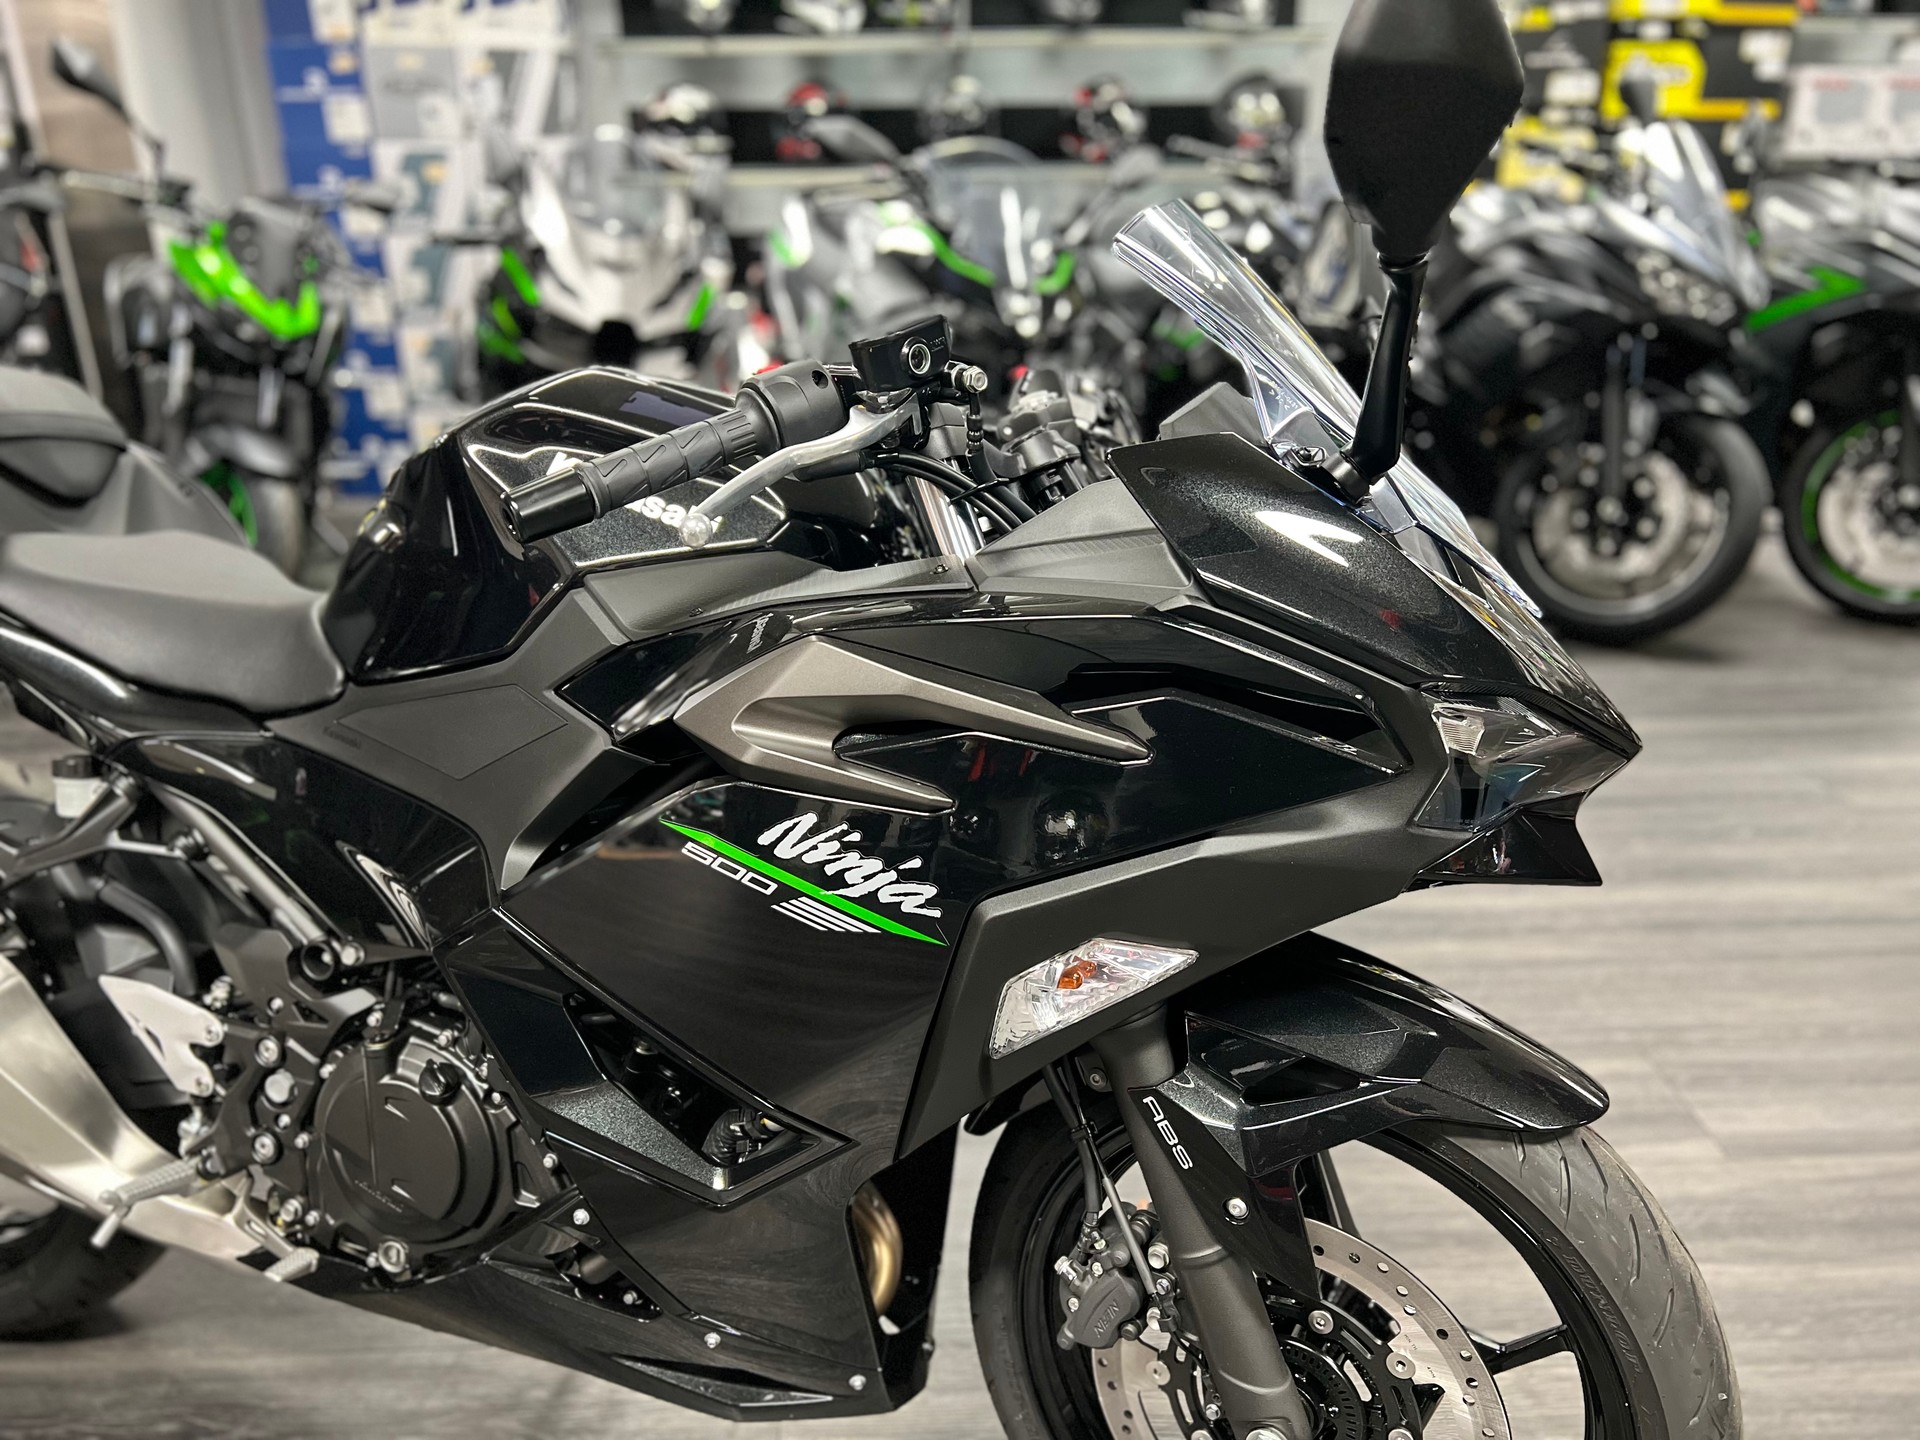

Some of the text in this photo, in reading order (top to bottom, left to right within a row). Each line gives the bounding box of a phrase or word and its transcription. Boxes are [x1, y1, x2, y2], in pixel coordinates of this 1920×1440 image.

[681, 841, 778, 896] 500
[757, 812, 942, 918] Ninja
[1142, 1096, 1193, 1170] ABS
